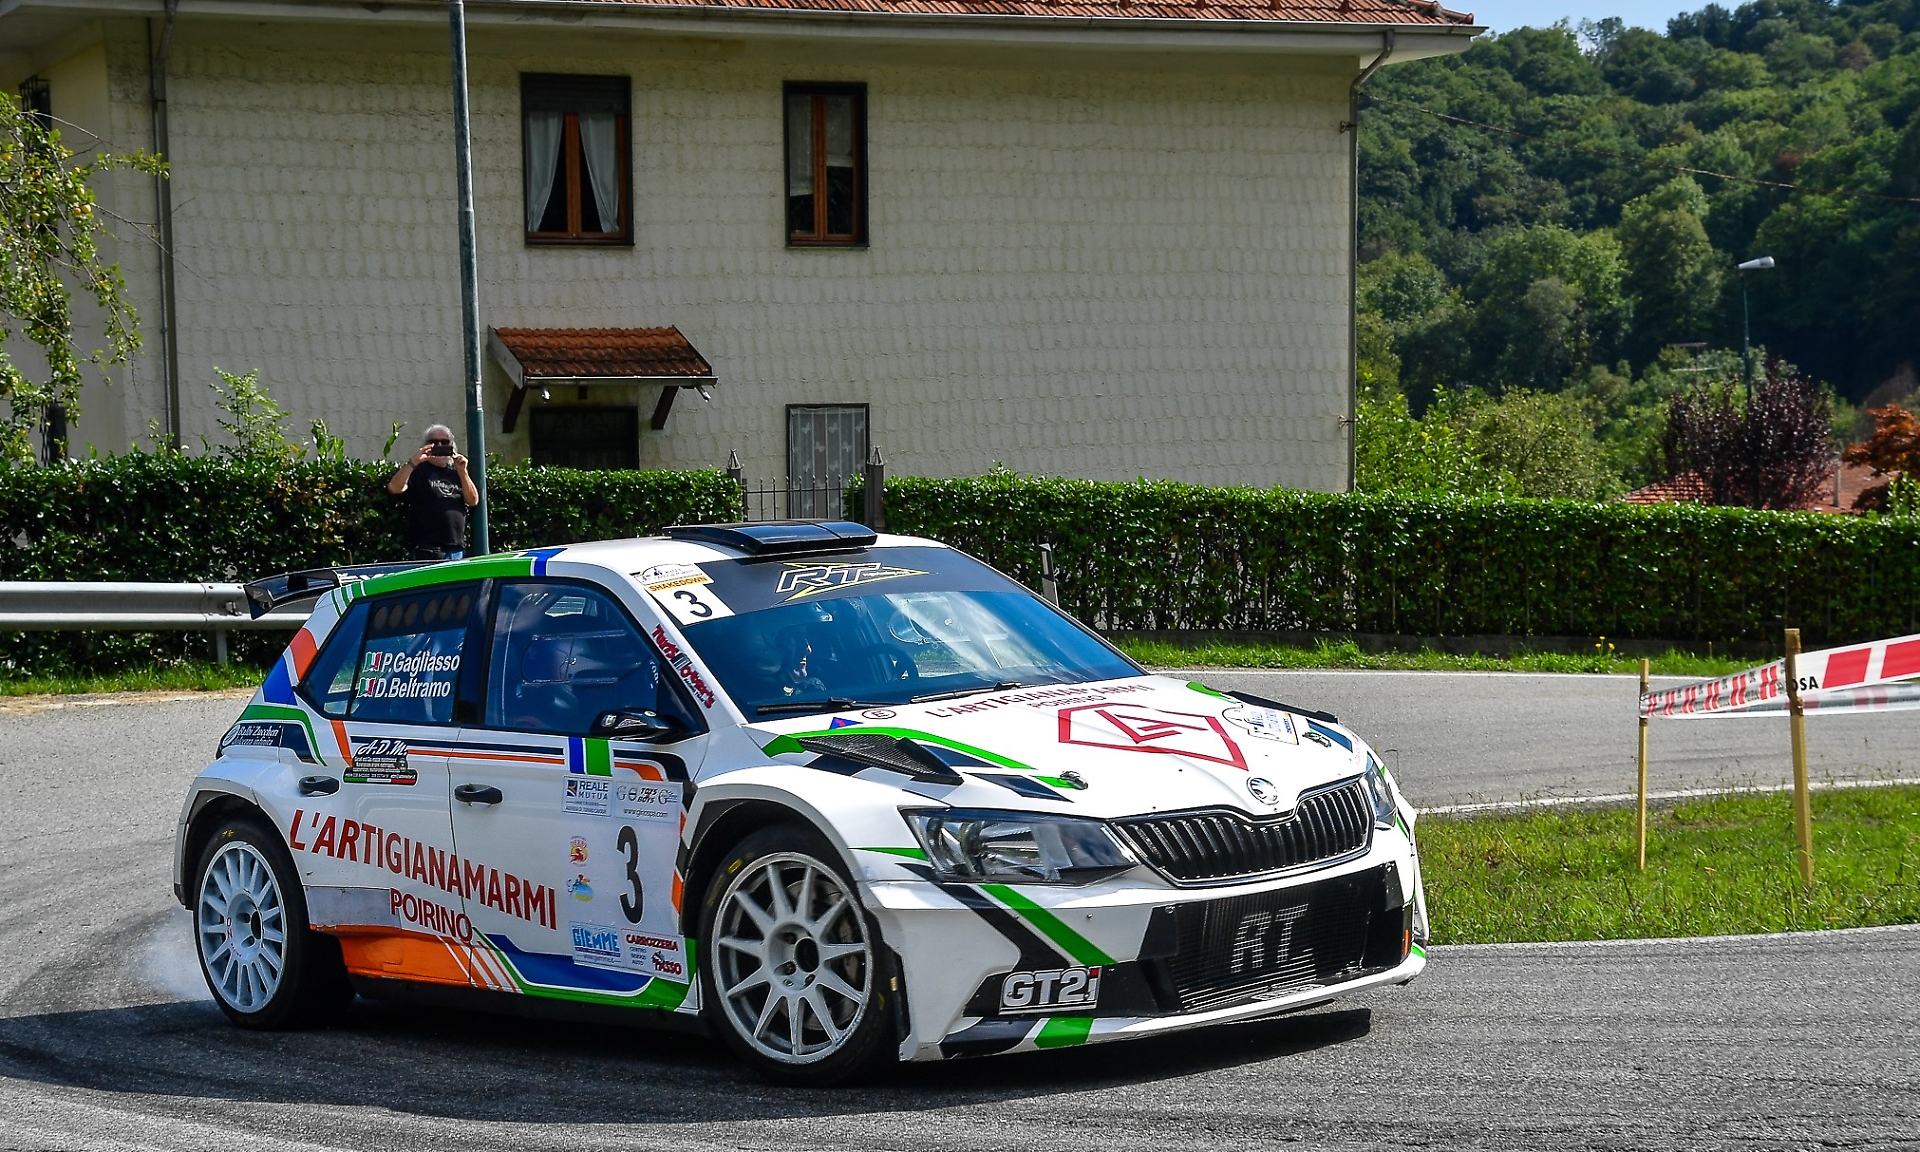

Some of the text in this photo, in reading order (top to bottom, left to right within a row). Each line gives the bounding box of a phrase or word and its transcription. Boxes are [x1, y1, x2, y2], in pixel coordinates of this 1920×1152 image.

[649, 576, 708, 591] SHAKEDOWN
[674, 590, 712, 617] 3
[381, 651, 460, 677] P.Gagliasso
[374, 677, 451, 698] D.Beltramo
[358, 740, 408, 756] A.D.M.
[578, 791, 608, 801] MUTUA
[580, 780, 609, 792] REALE
[289, 809, 557, 931] L'ARTIGIANAMARMI
[616, 826, 644, 924] 3
[390, 888, 473, 943] POIRINO
[572, 928, 620, 952] GIEMME
[626, 934, 679, 951] CARROZZERIA
[1003, 967, 1100, 1008] GT2i
